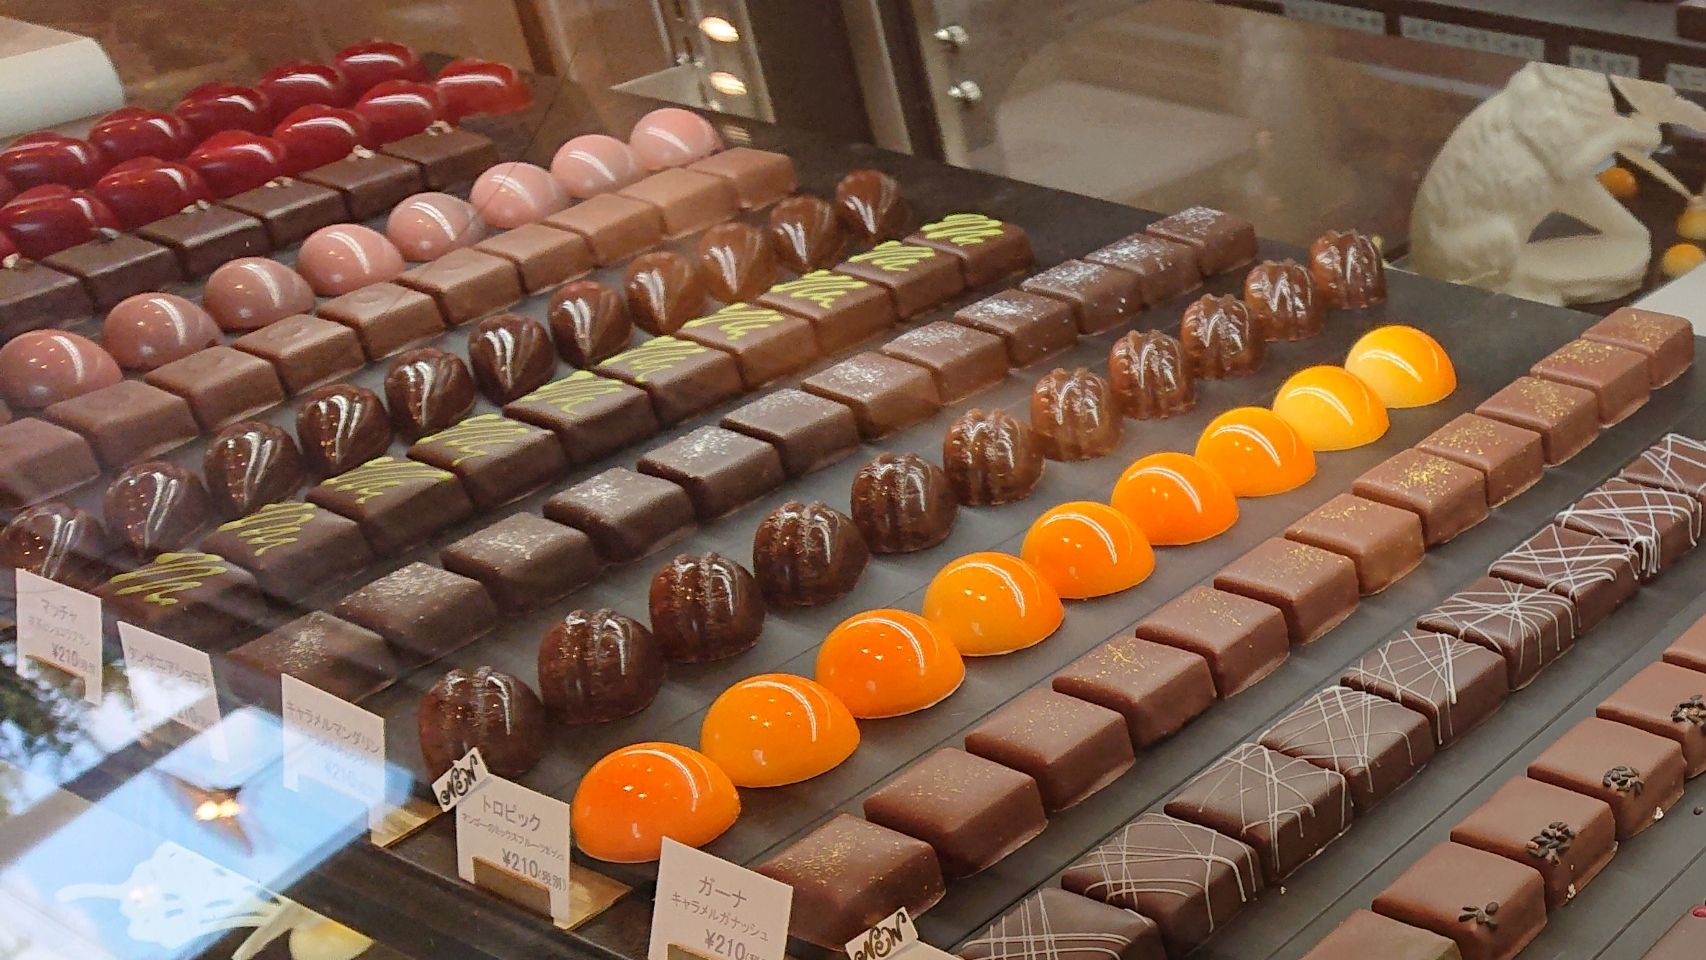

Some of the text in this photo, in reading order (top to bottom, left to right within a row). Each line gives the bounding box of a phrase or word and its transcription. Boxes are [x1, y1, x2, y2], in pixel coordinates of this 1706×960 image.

[698, 876, 747, 908] ガーナ
[672, 892, 769, 941] キャラメルガナッシュ
